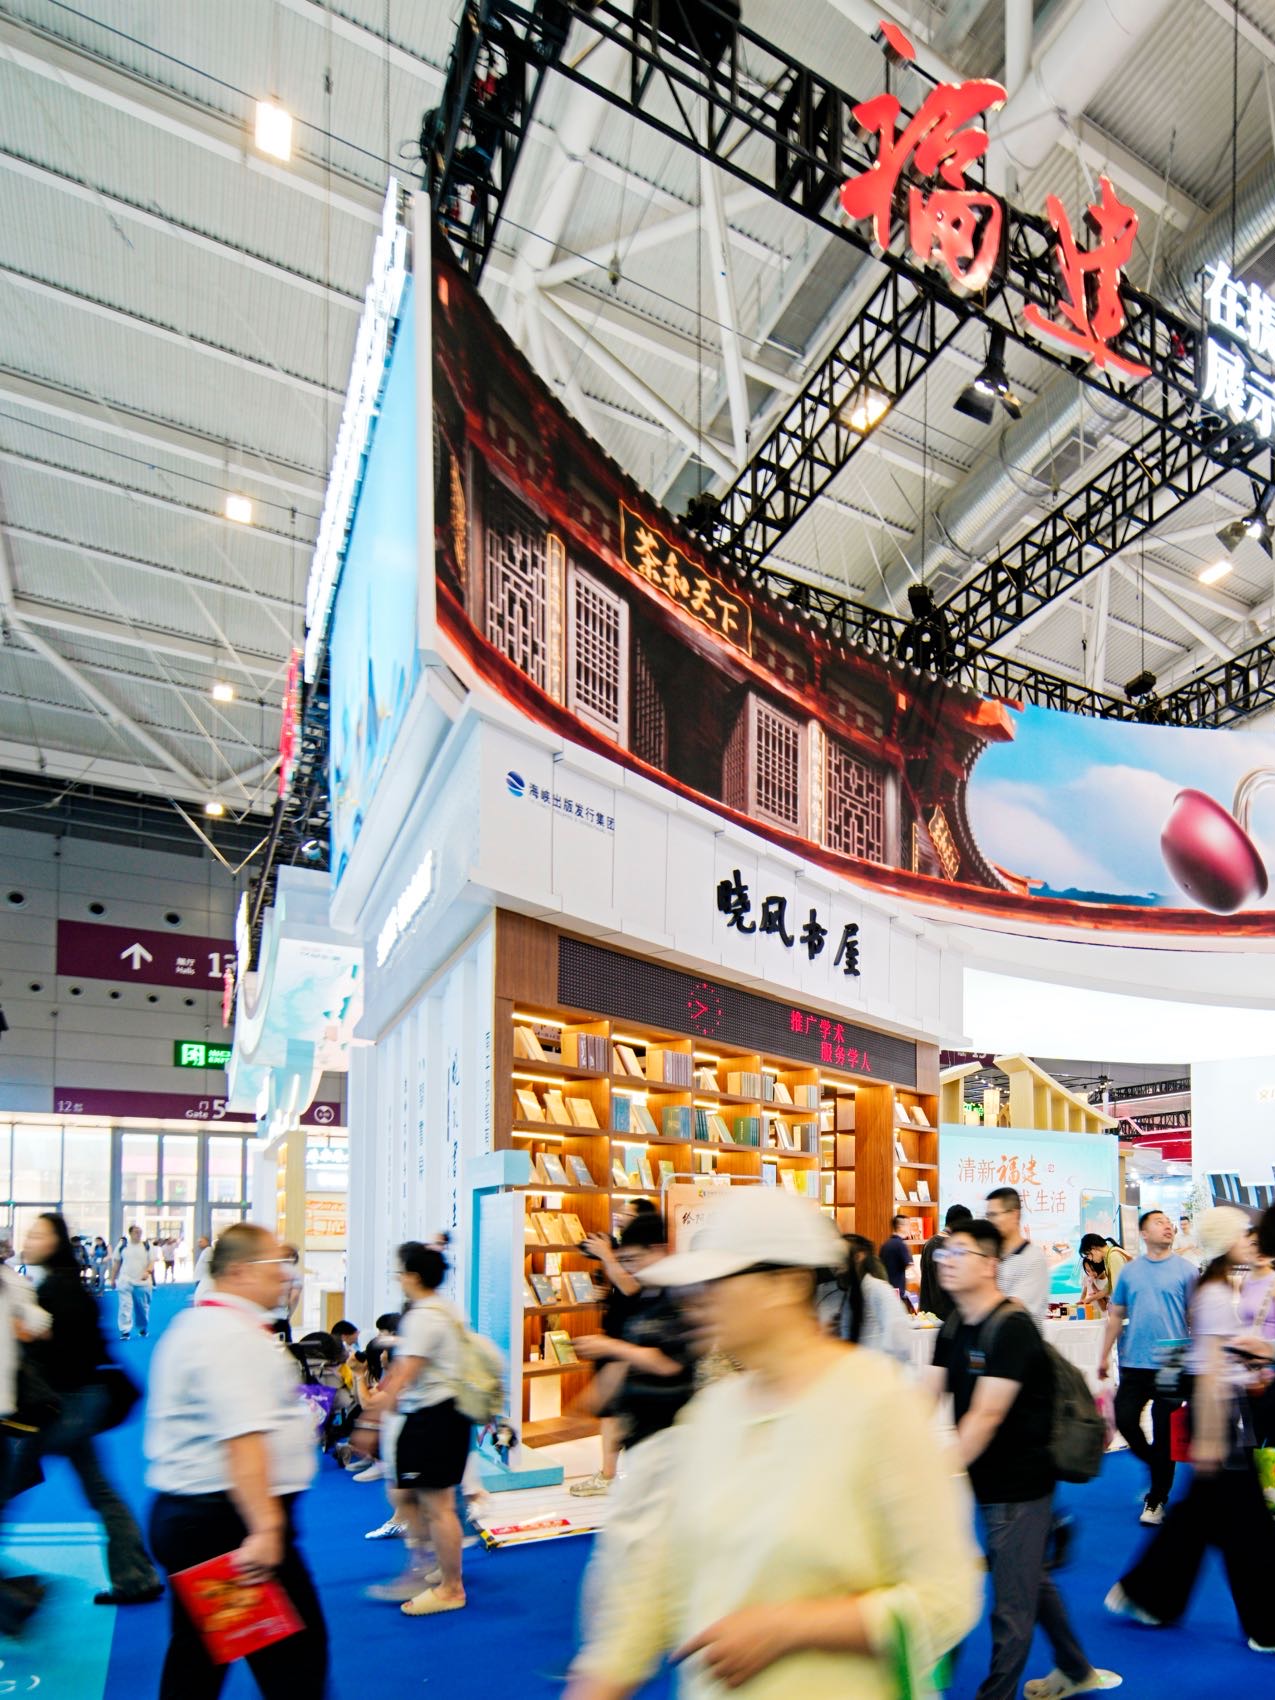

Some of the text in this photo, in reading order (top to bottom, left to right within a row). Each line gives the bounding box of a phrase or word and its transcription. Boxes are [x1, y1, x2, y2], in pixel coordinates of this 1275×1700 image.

[528, 783, 615, 831] 海峡出版发行集团
[716, 869, 862, 976] 晓风书屋
[790, 1009, 846, 1042] 推广学术
[820, 1041, 871, 1072] 服务学人
[185, 1109, 209, 1119] Gate
